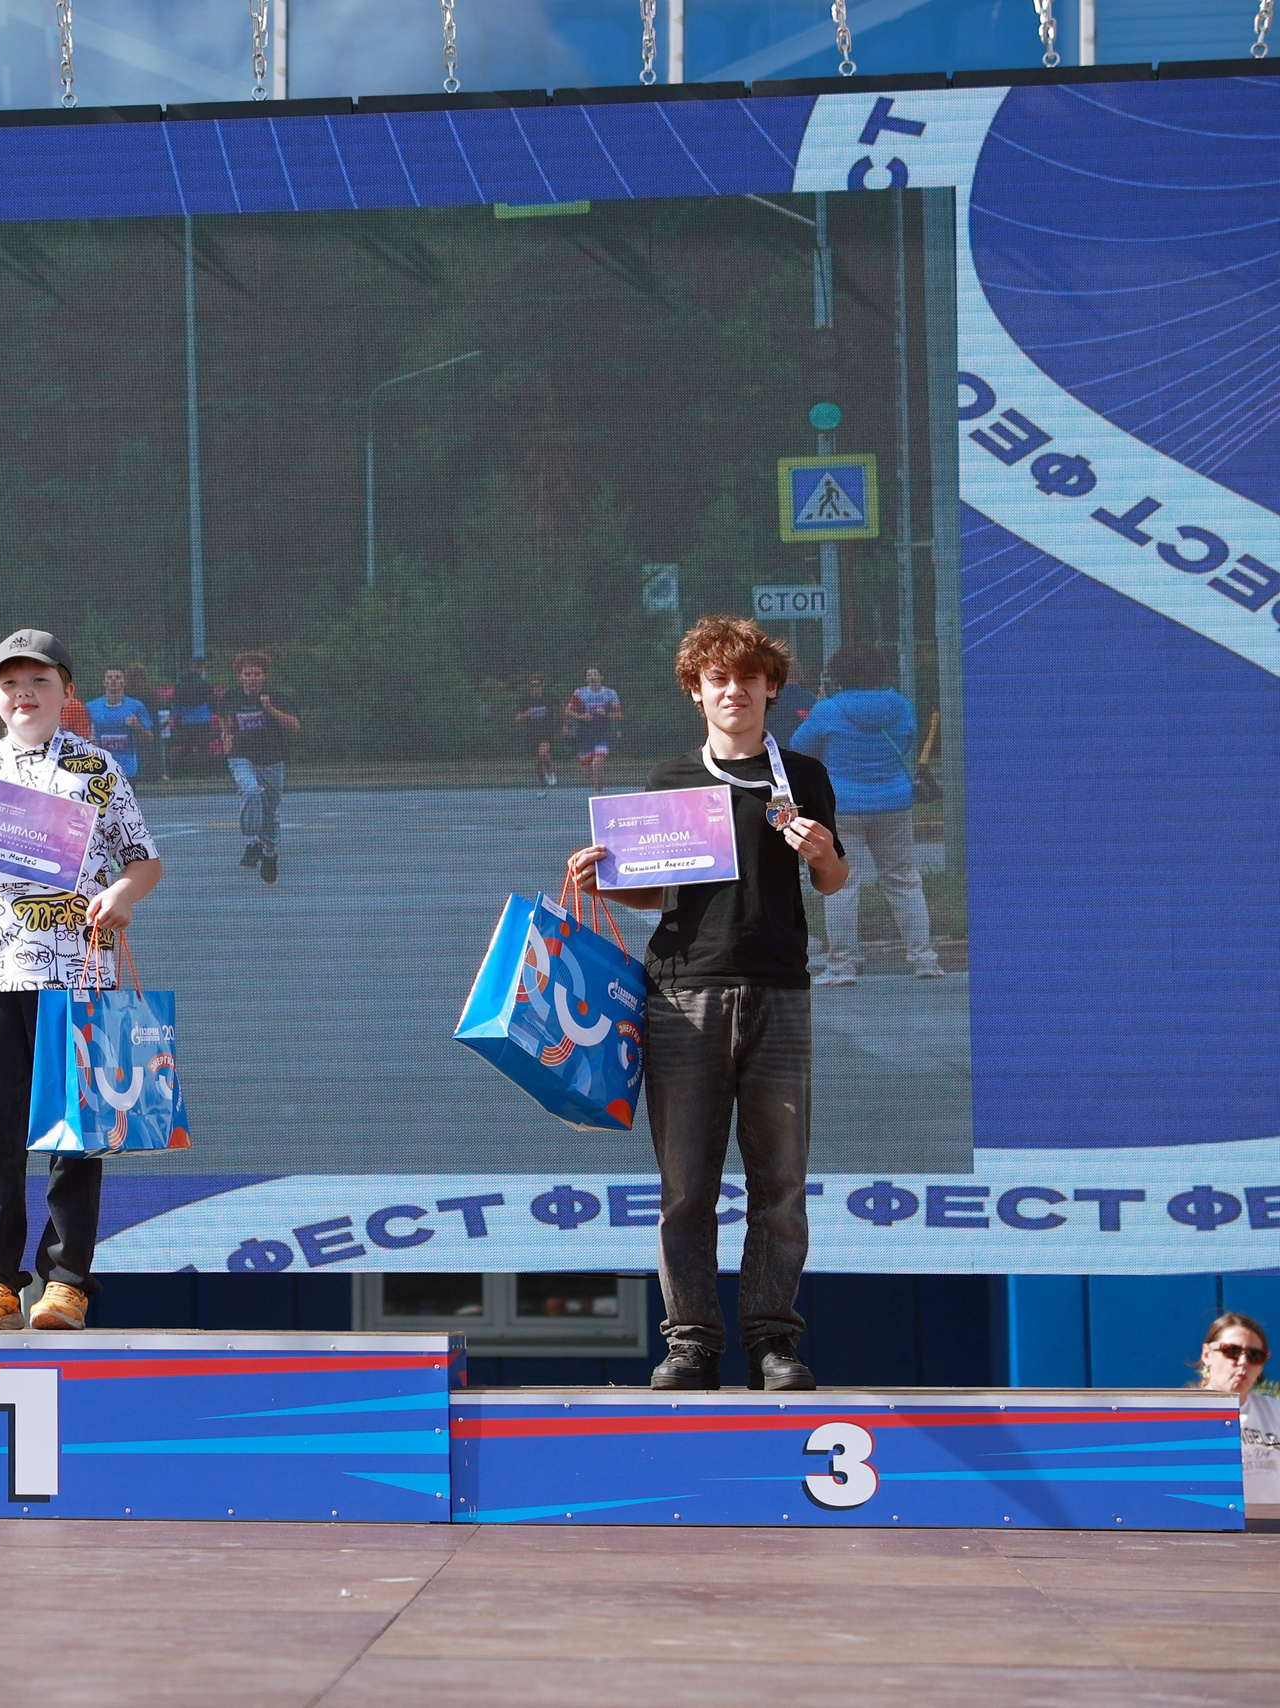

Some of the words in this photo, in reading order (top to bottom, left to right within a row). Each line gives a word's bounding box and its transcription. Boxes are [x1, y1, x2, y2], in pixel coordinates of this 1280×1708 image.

[1090, 495, 1280, 633] ЕСТ
[757, 591, 826, 613] СТОП
[618, 820, 638, 828] ЗАБЕГ
[638, 831, 690, 845] ДИПЛОМ
[162, 1025, 175, 1041] 20
[227, 1193, 505, 1272] ФЕСТ
[846, 1180, 1147, 1232] ФЕСТ
[802, 1422, 878, 1510] 3
